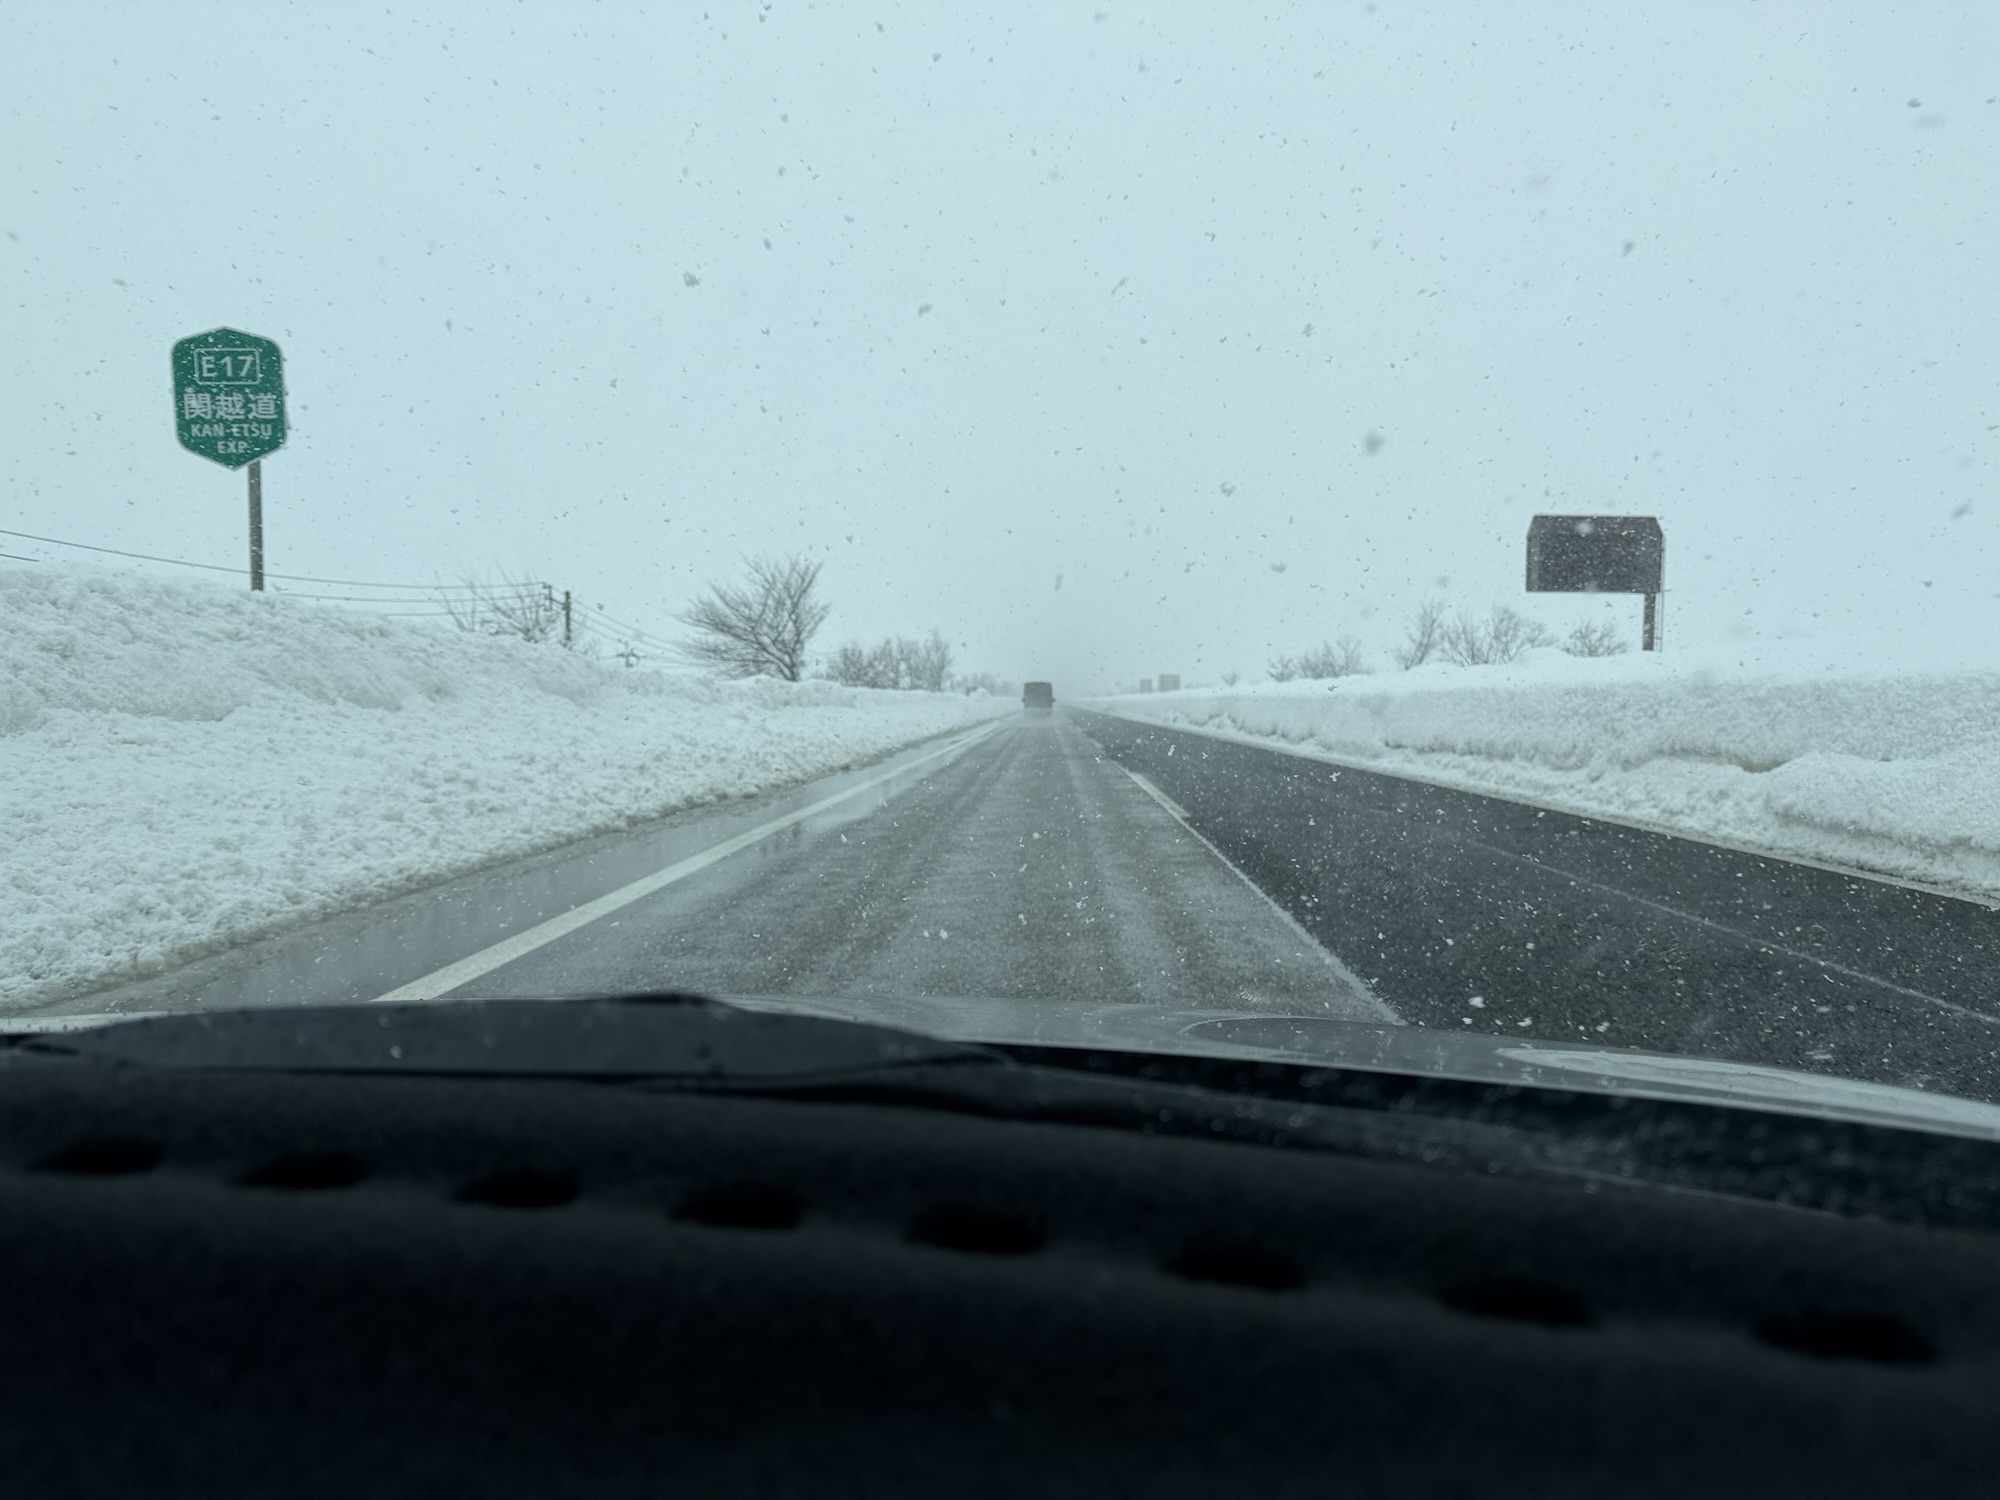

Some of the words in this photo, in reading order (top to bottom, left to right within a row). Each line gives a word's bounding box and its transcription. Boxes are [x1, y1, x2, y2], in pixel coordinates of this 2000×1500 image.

[201, 355, 255, 377] E17
[183, 392, 278, 420] 関越道
[191, 423, 273, 437] KAN-ETSU
